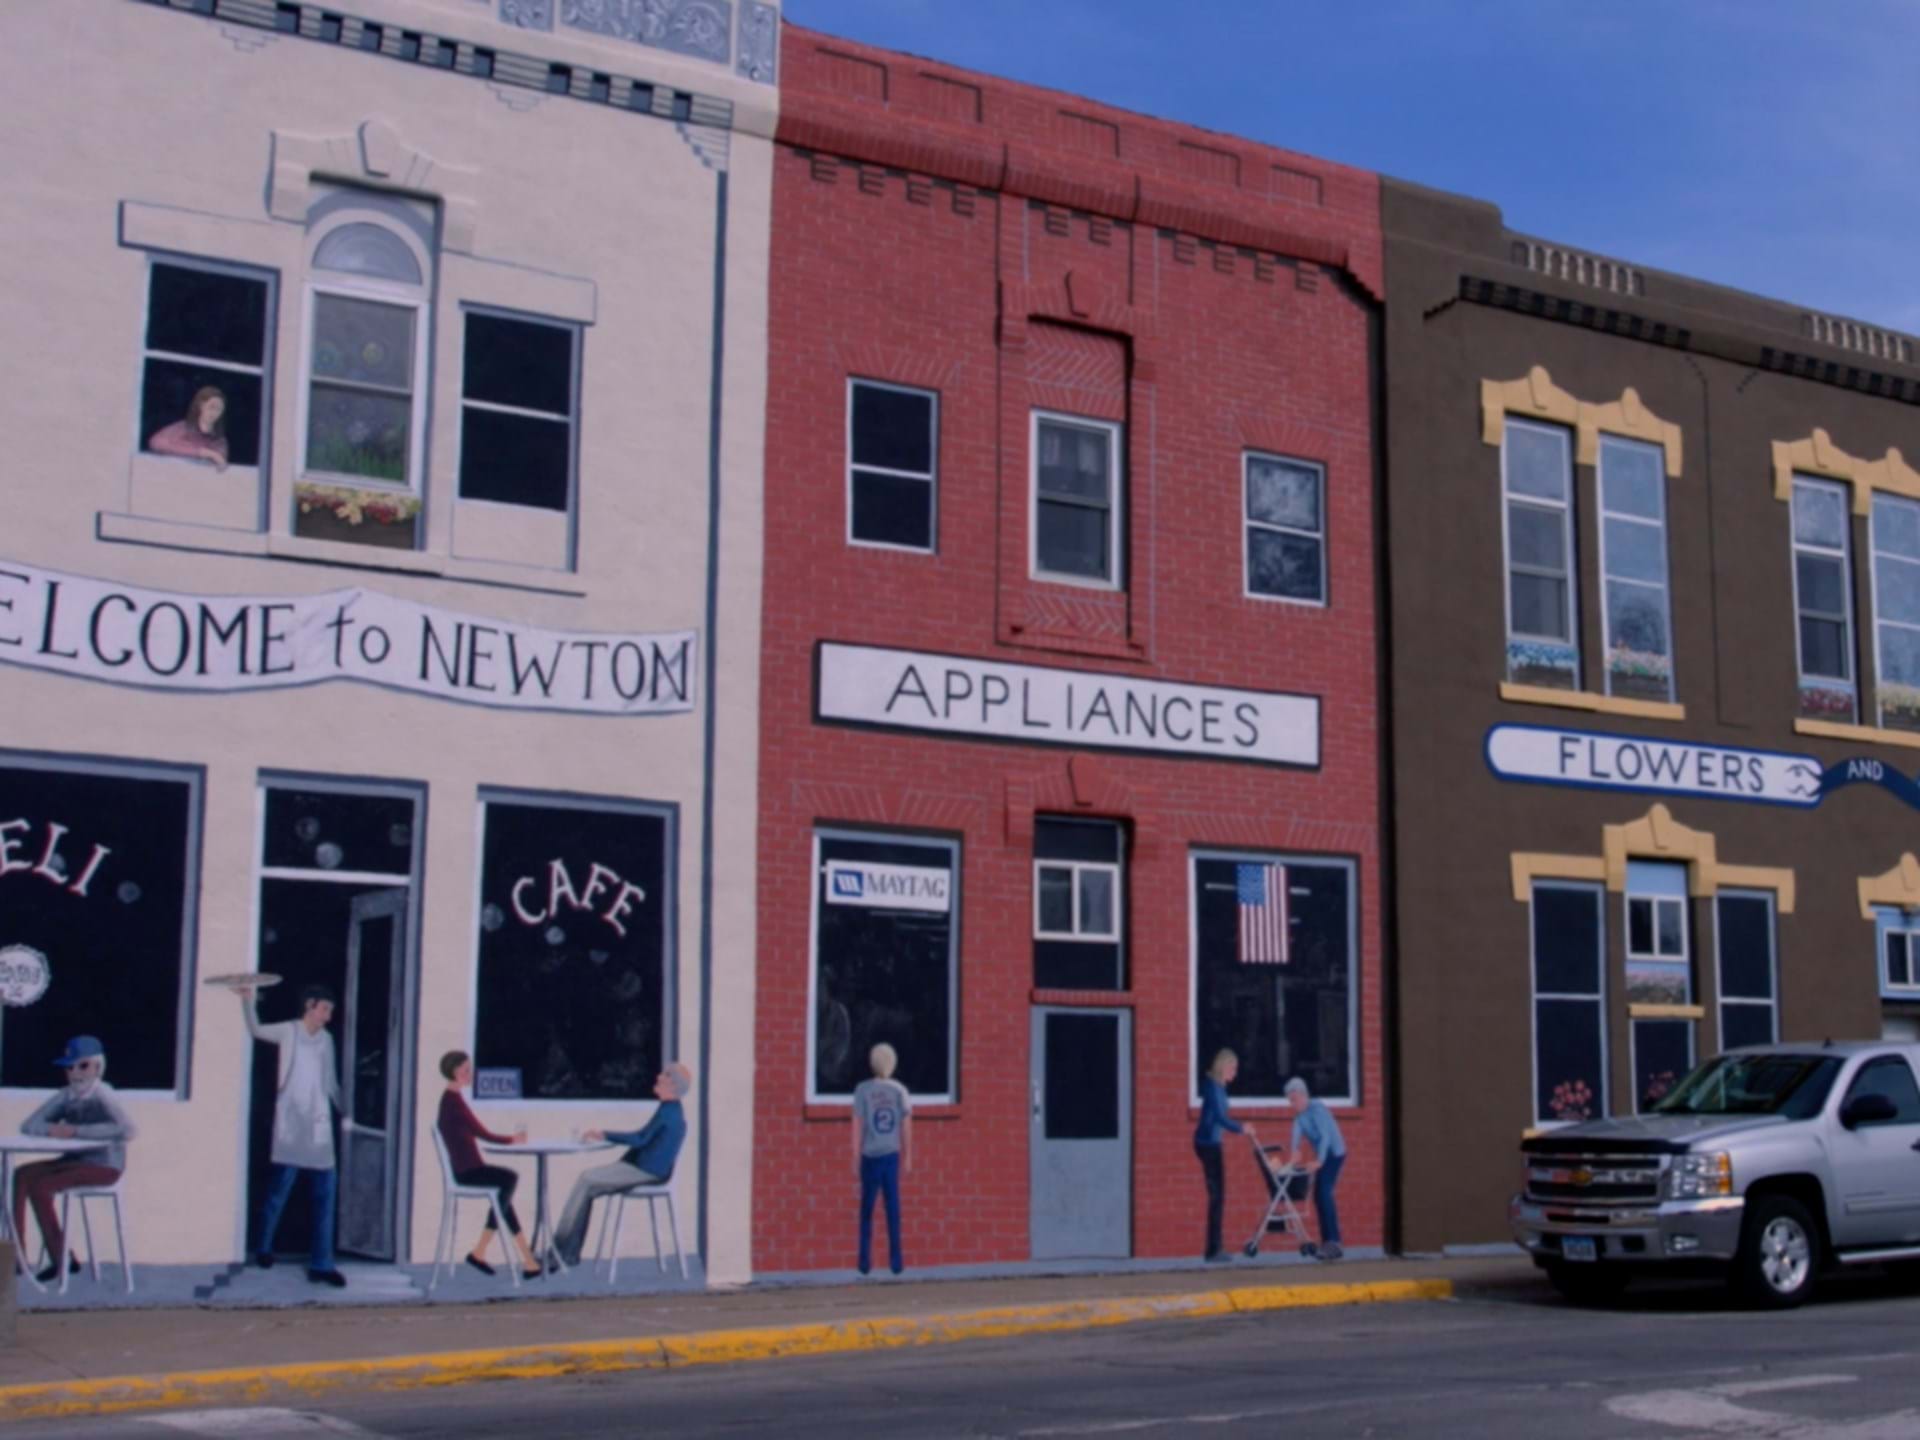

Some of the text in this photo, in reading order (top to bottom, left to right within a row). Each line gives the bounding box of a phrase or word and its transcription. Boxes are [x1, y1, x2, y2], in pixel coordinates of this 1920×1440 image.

[326, 606, 391, 667] to
[419, 614, 692, 701] NEWTON
[885, 664, 1261, 747] APPLIANCES
[1559, 736, 1884, 793] FLOWERS AND
[0, 818, 111, 896] ELI
[867, 873, 945, 898] MAYTAG
[512, 859, 645, 935] CAFE
